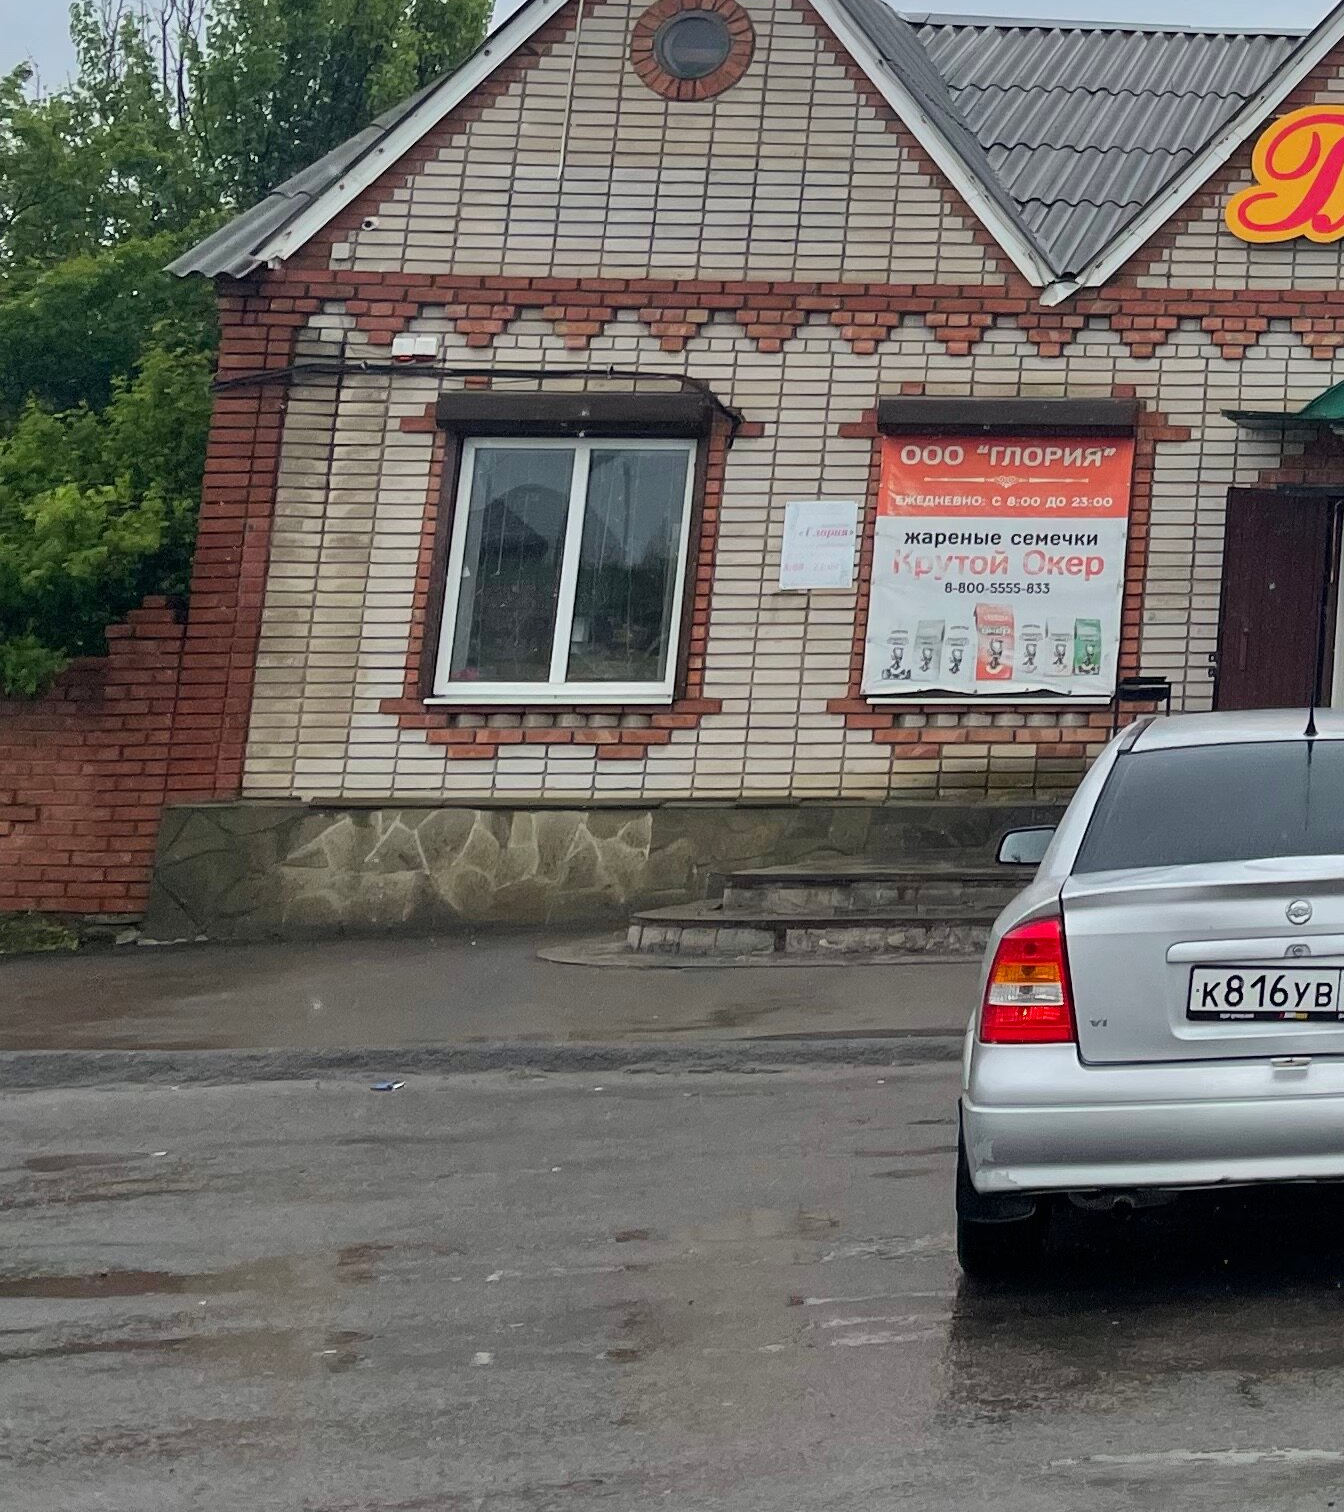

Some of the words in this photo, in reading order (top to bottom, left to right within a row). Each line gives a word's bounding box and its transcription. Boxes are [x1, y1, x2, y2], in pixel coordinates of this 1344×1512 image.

[901, 445, 965, 466] ООО
[1007, 496, 1041, 507] 8:00
[1045, 496, 1066, 508] ДО
[1071, 497, 1113, 507] 23:00
[904, 531, 1002, 548] жареные
[1010, 531, 1098, 546] семечки
[893, 549, 1009, 580] Крутой
[1023, 550, 1104, 581] Окер
[944, 582, 1050, 594] 8-800-5555-833
[1201, 975, 1333, 1007] К816УВ
